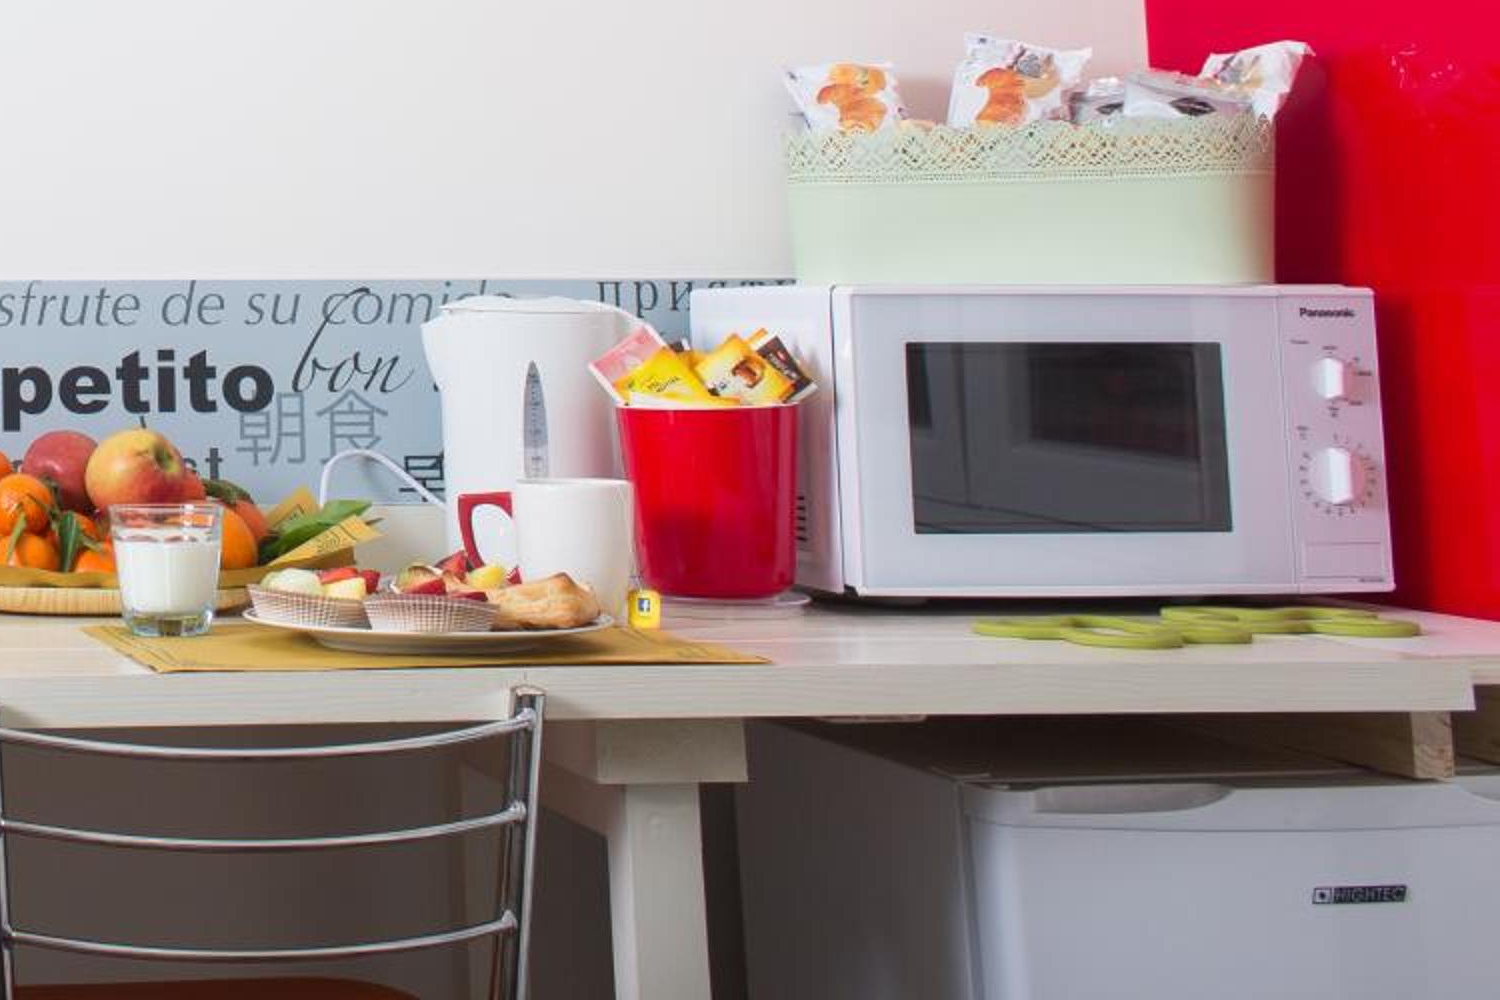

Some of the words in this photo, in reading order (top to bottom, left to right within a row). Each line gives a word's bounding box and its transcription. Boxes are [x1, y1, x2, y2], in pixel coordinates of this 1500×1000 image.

[161, 280, 225, 326] de
[244, 292, 302, 326] su
[291, 286, 415, 393] bon
[235, 389, 389, 466] 朝食
